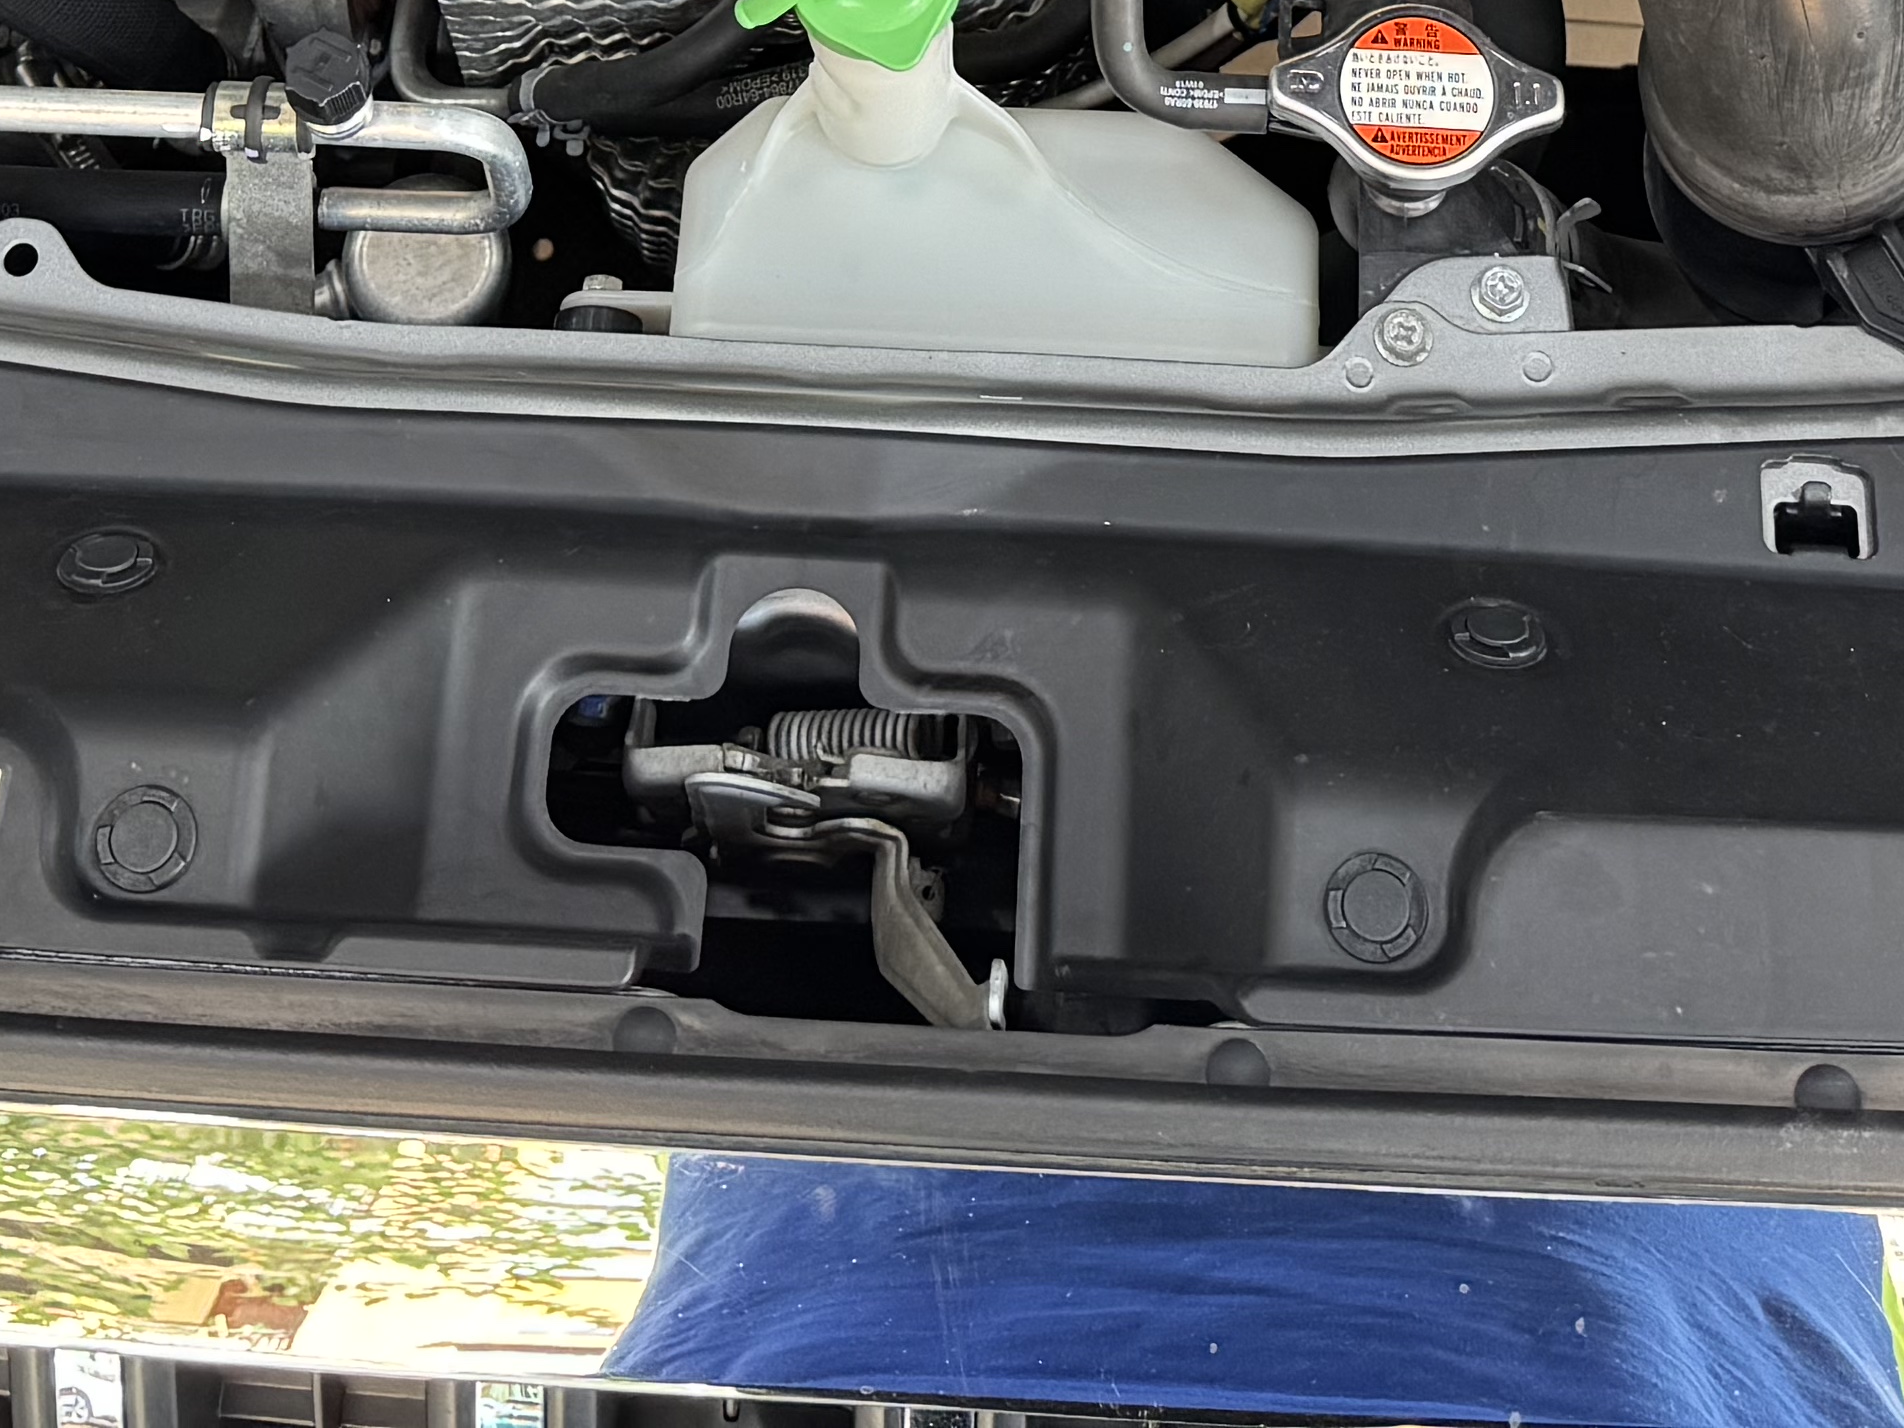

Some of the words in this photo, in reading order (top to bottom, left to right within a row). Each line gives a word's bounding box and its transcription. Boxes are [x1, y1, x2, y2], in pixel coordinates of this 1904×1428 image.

[1394, 38, 1440, 50] WARNING
[1352, 68, 1381, 79] NEVER
[1386, 70, 1410, 80] OPEN
[1416, 71, 1442, 83] WHEN
[1351, 82, 1362, 93] NE
[1367, 83, 1399, 94] JAMAIS
[1404, 84, 1436, 96] OUVRIR
[1351, 96, 1363, 107] NO
[1368, 97, 1396, 109] ABRIR
[1402, 99, 1434, 111] NUNCA
[1440, 101, 1478, 113] CUANDO
[1352, 111, 1372, 122] ESTE
[1390, 131, 1468, 146] AVERTISSEMENT
[1390, 144, 1447, 157] ADVERTENCIA
